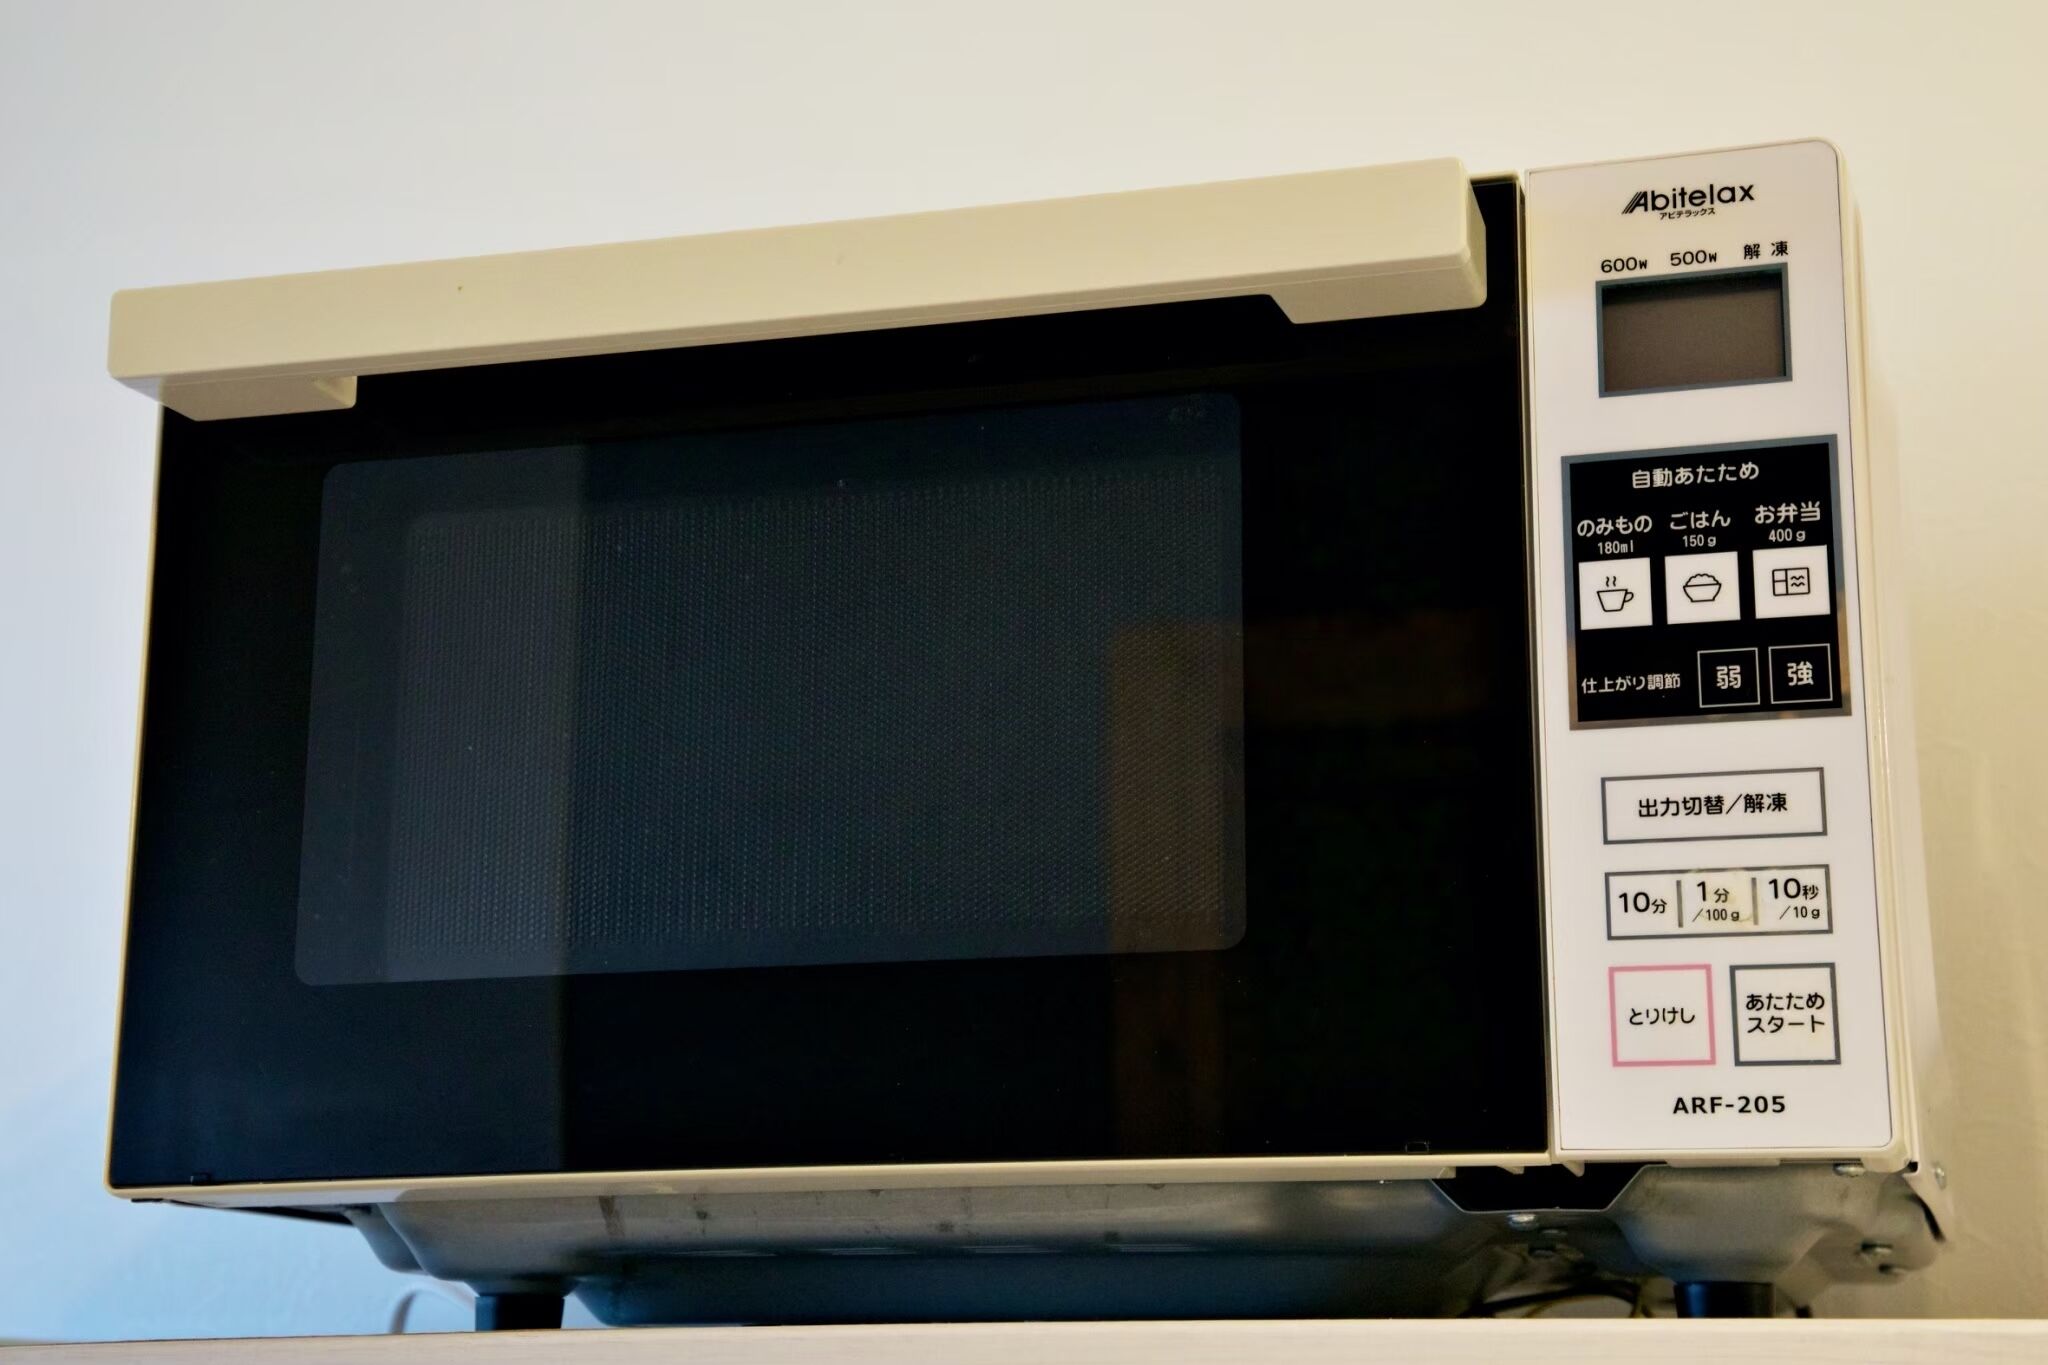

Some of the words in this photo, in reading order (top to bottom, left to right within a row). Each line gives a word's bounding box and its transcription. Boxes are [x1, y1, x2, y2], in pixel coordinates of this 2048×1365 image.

[1621, 184, 1755, 214] Abitelax
[1660, 207, 1716, 220] アビテラックス
[1631, 462, 1759, 489] 自動あたため
[1669, 510, 1731, 530] ごはん
[1754, 501, 1821, 525] お弁当
[1577, 515, 1653, 537] のみもの
[1597, 540, 1634, 555] 180ml
[1581, 672, 1681, 694] 仕上がり調節
[1716, 665, 1742, 689] 弱
[1787, 661, 1814, 686] 強
[1696, 881, 1730, 903] 1分
[1768, 877, 1820, 901] 10秒
[1618, 892, 1667, 914] 10分
[1745, 993, 1825, 1012] あたため
[1629, 1007, 1696, 1026] とりけし
[1747, 1014, 1826, 1034] スタート
[1673, 1095, 1786, 1115] ARF-205
